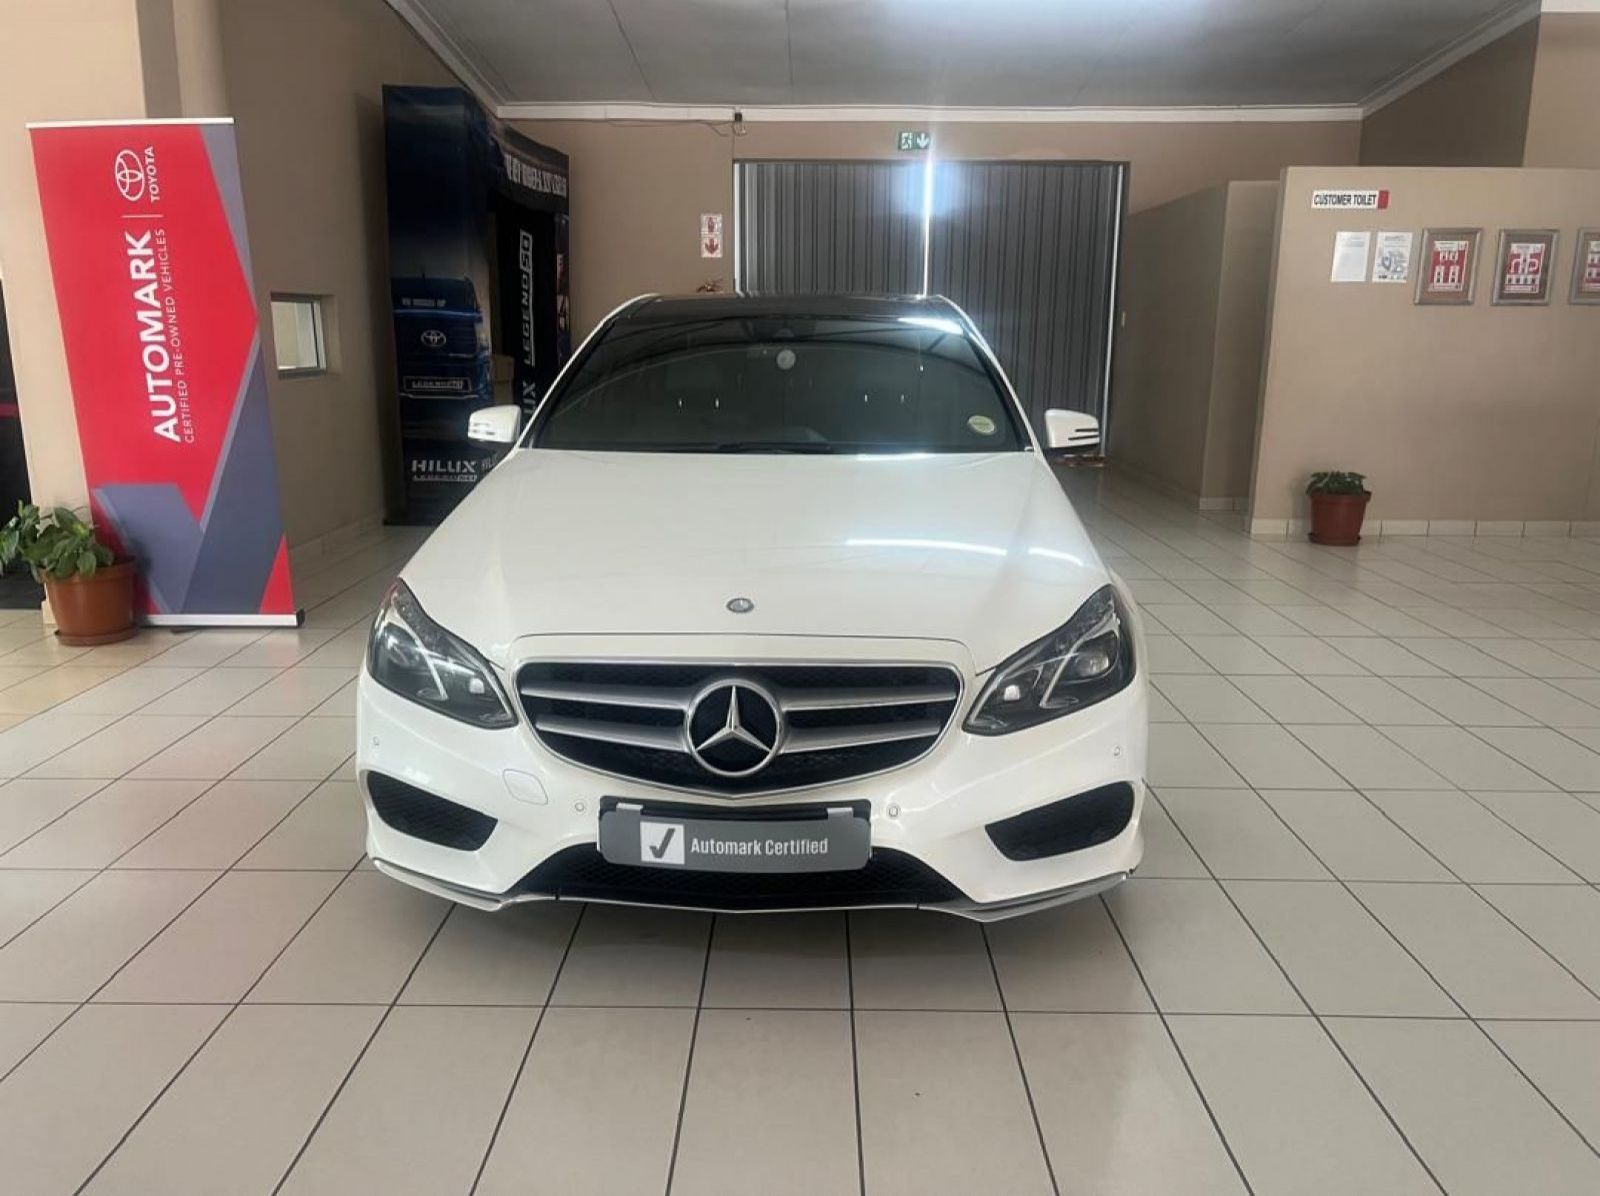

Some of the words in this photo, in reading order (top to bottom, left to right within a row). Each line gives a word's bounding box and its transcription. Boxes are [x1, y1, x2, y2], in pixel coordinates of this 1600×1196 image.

[144, 146, 160, 203] TOYOTA
[1314, 194, 1352, 205] CUSTOMER
[1353, 194, 1377, 205] TOILET
[154, 228, 174, 293] VEHICLES
[124, 229, 181, 443] AUTOMARK
[165, 297, 184, 376] PRE-OWNED
[177, 380, 195, 444] CERTIFIED
[412, 459, 476, 473] HILUX
[690, 838, 762, 855] Automark
[765, 838, 829, 855] Certified
